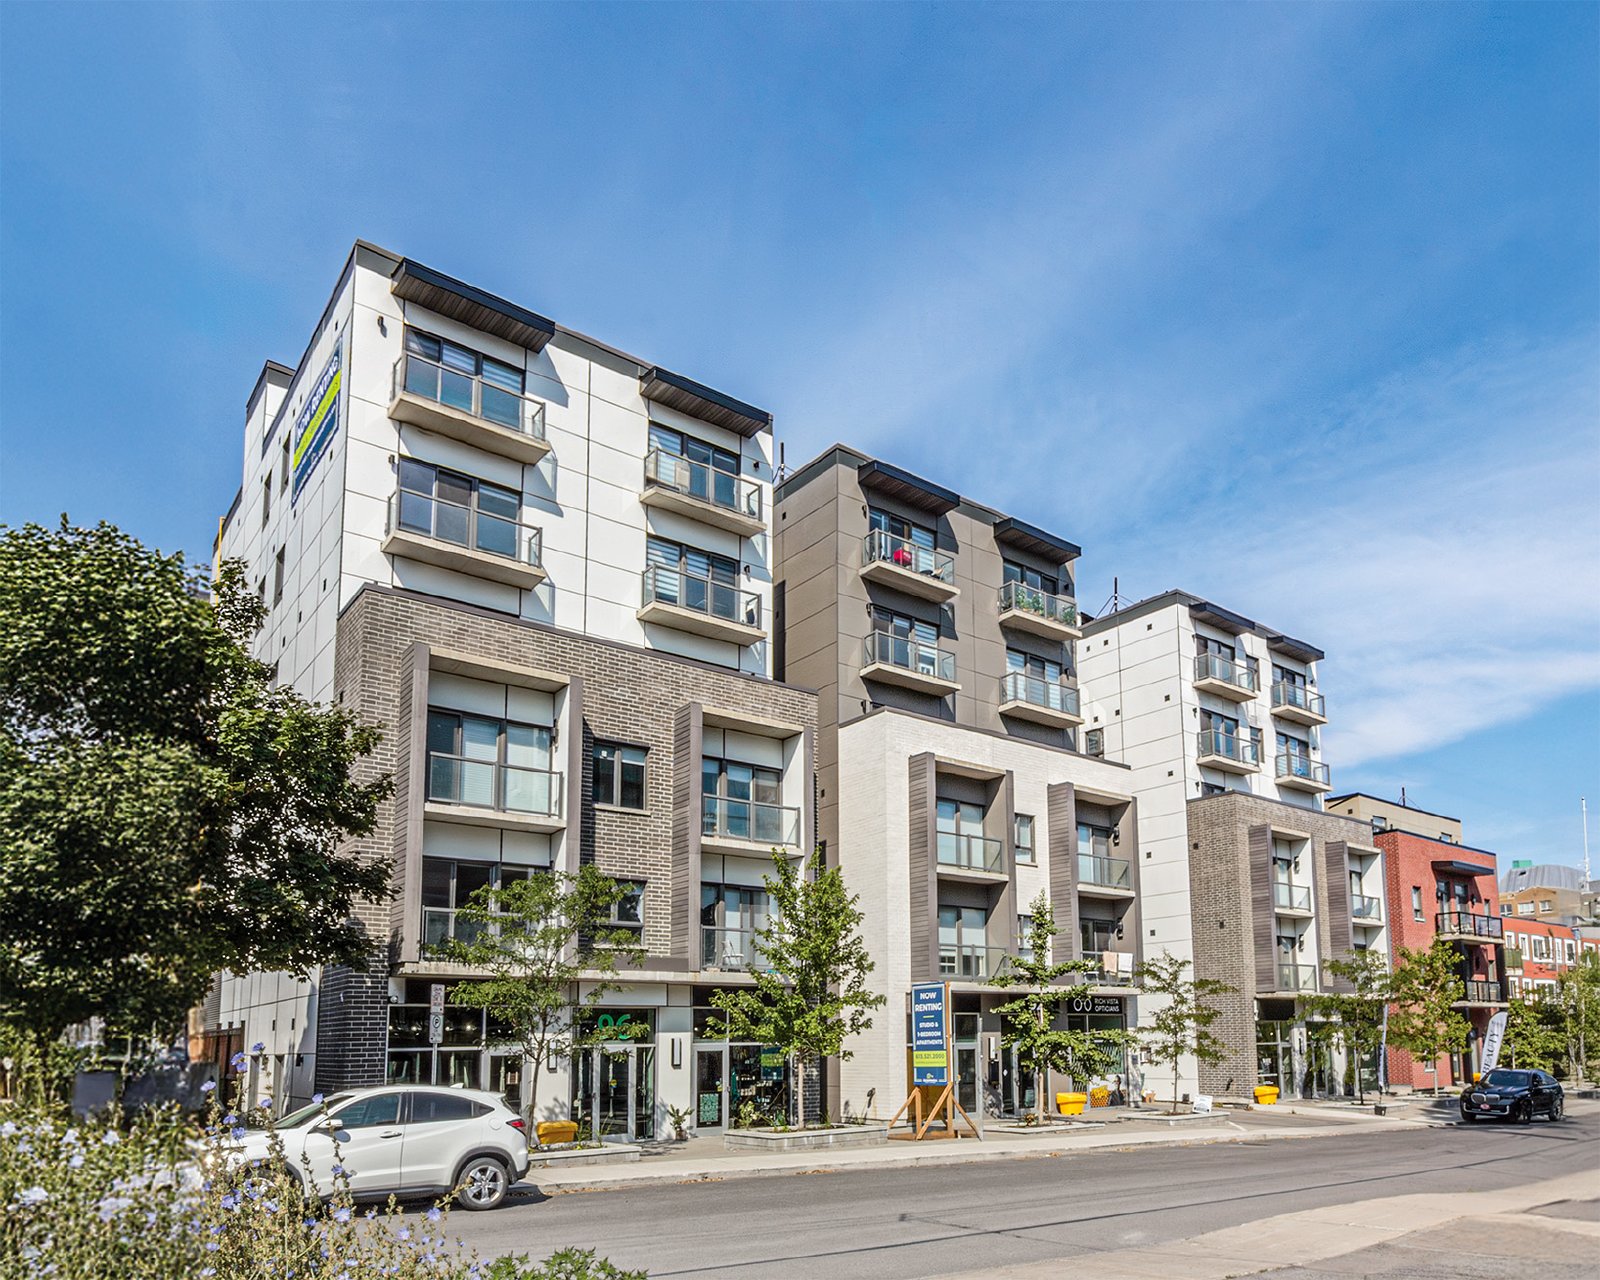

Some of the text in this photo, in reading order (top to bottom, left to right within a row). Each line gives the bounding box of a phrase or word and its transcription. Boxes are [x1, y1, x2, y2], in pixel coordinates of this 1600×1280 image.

[310, 355, 339, 415] RENTING
[915, 1002, 942, 1012] RENTING
[920, 992, 937, 1000] NOW
[1482, 1033, 1499, 1075] BEAUTY
